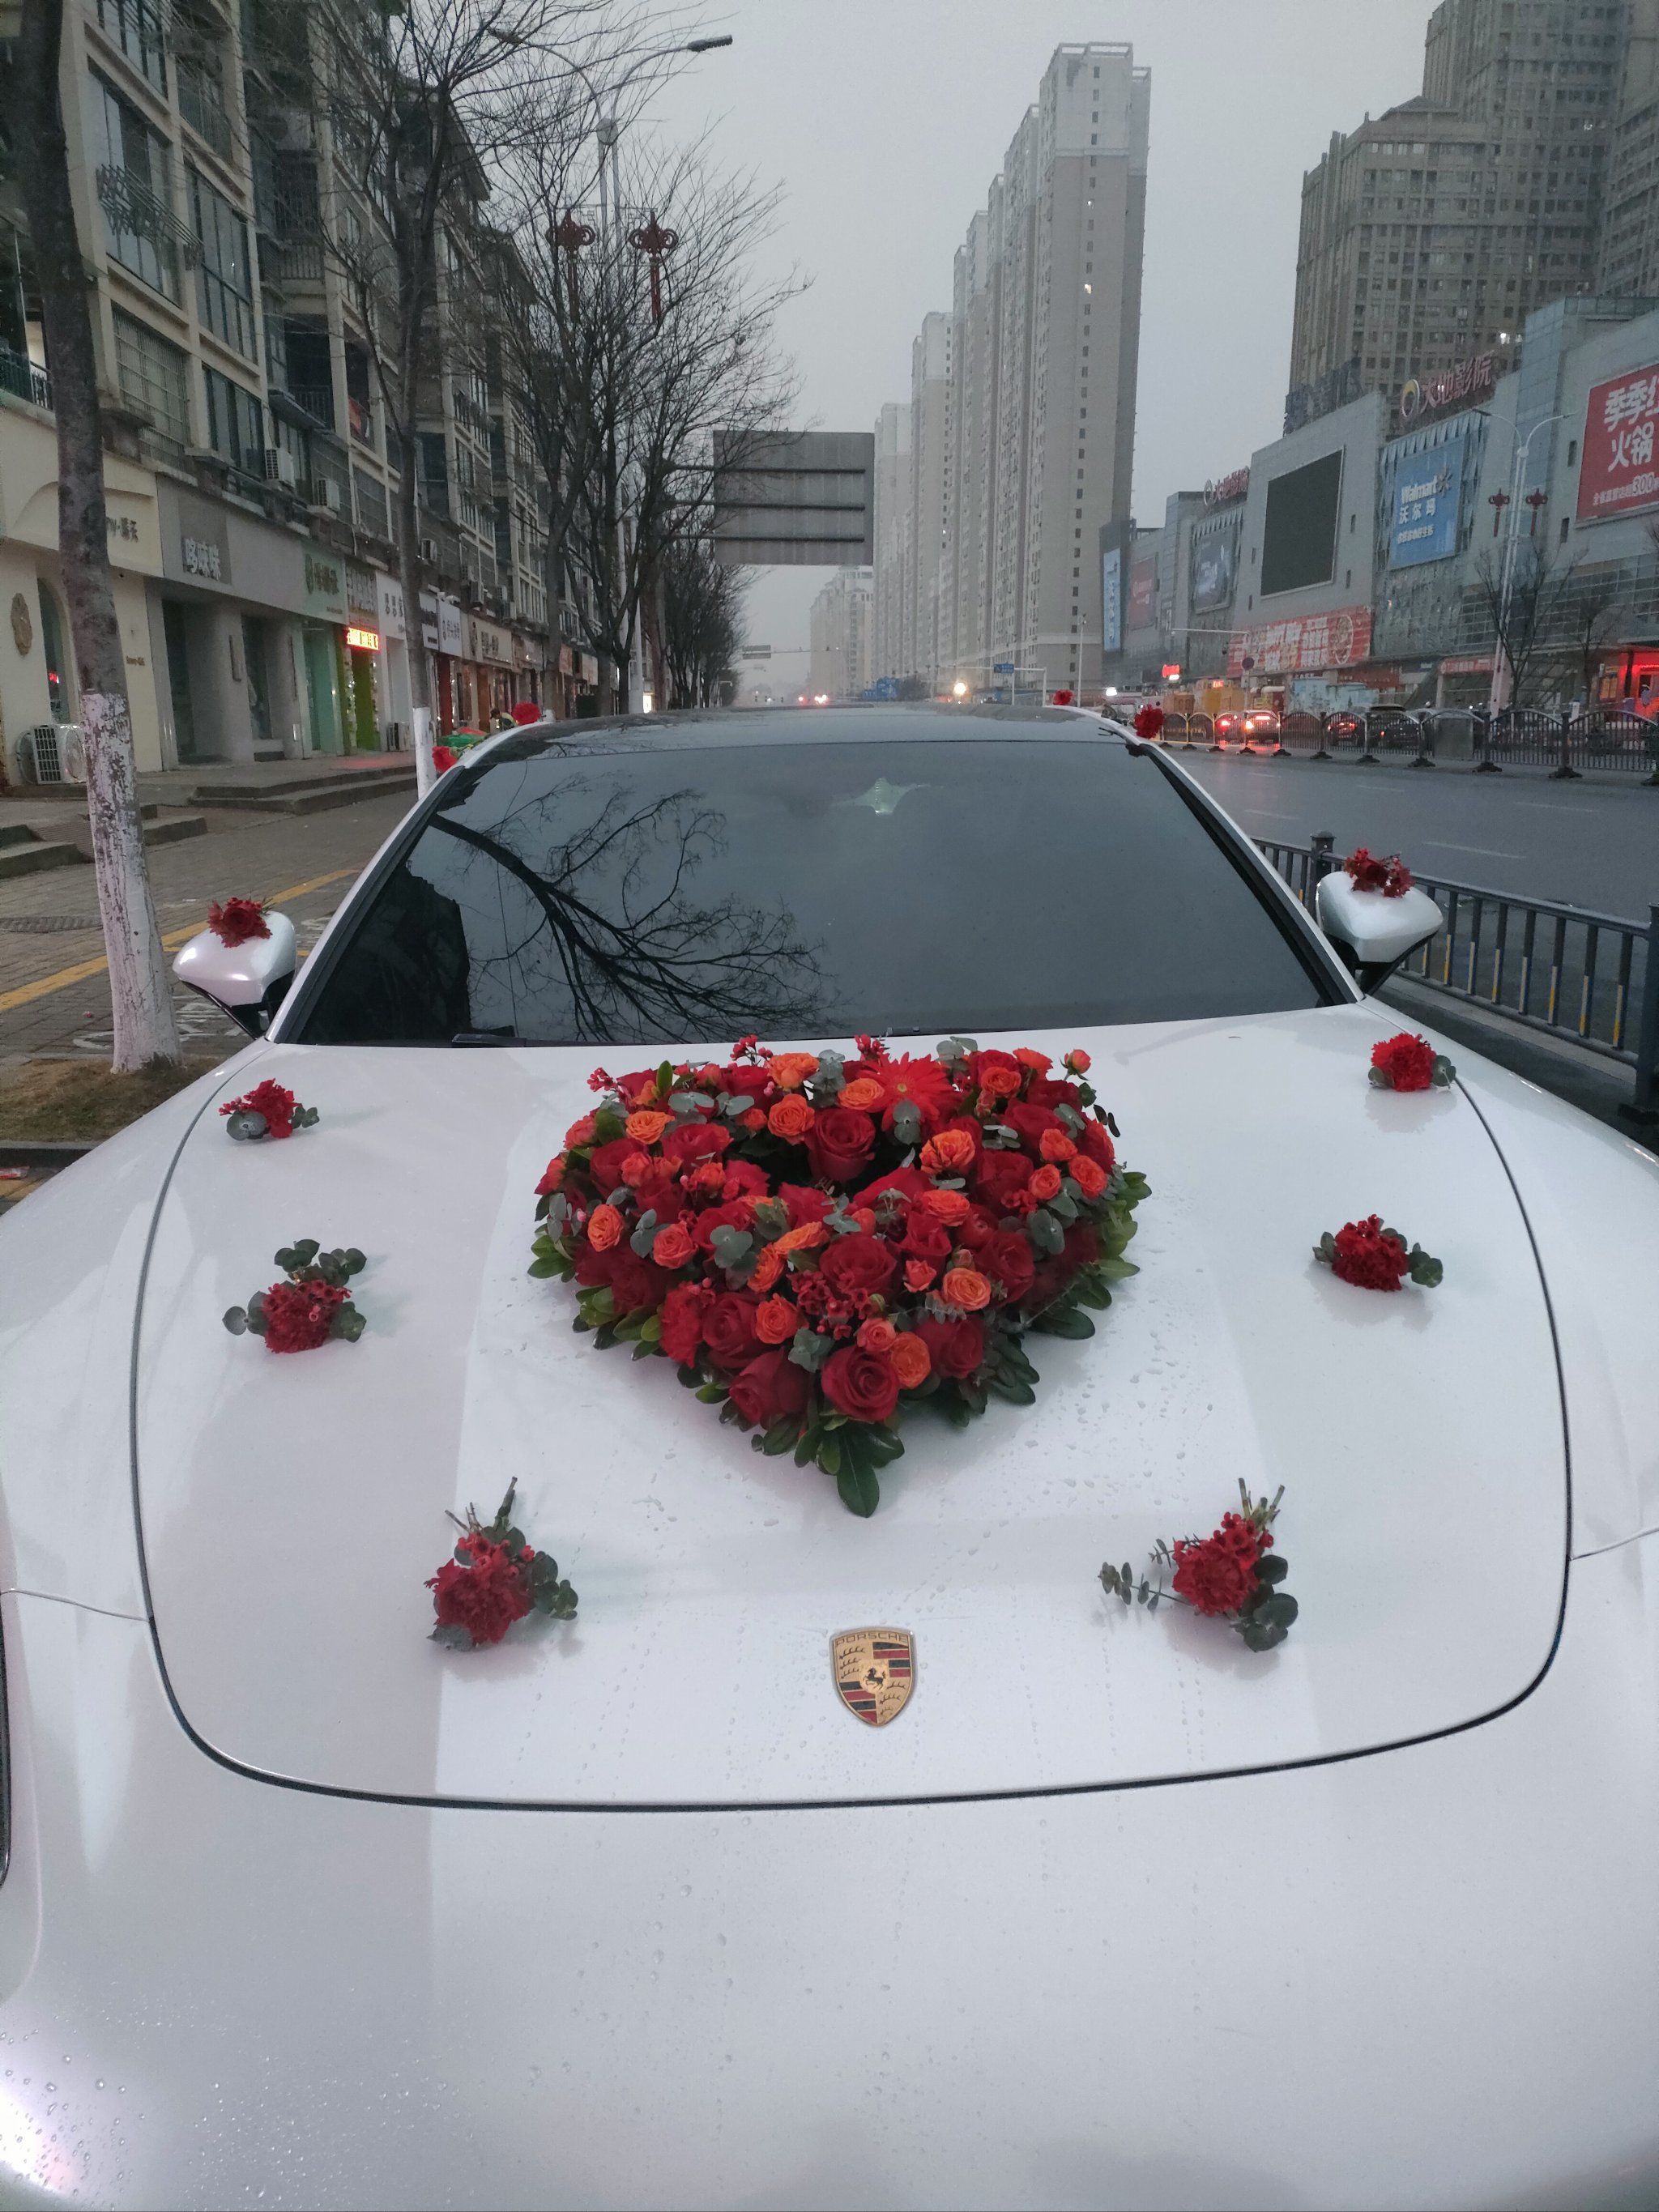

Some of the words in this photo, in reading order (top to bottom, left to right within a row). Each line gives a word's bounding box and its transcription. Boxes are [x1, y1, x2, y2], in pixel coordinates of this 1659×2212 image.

[1419, 353, 1491, 413] 大地影院
[1607, 420, 1654, 472] 火锅
[1401, 475, 1437, 503] Walmart
[1398, 497, 1436, 524] 沃尔玛
[835, 1632, 909, 1647] PORSCHE
